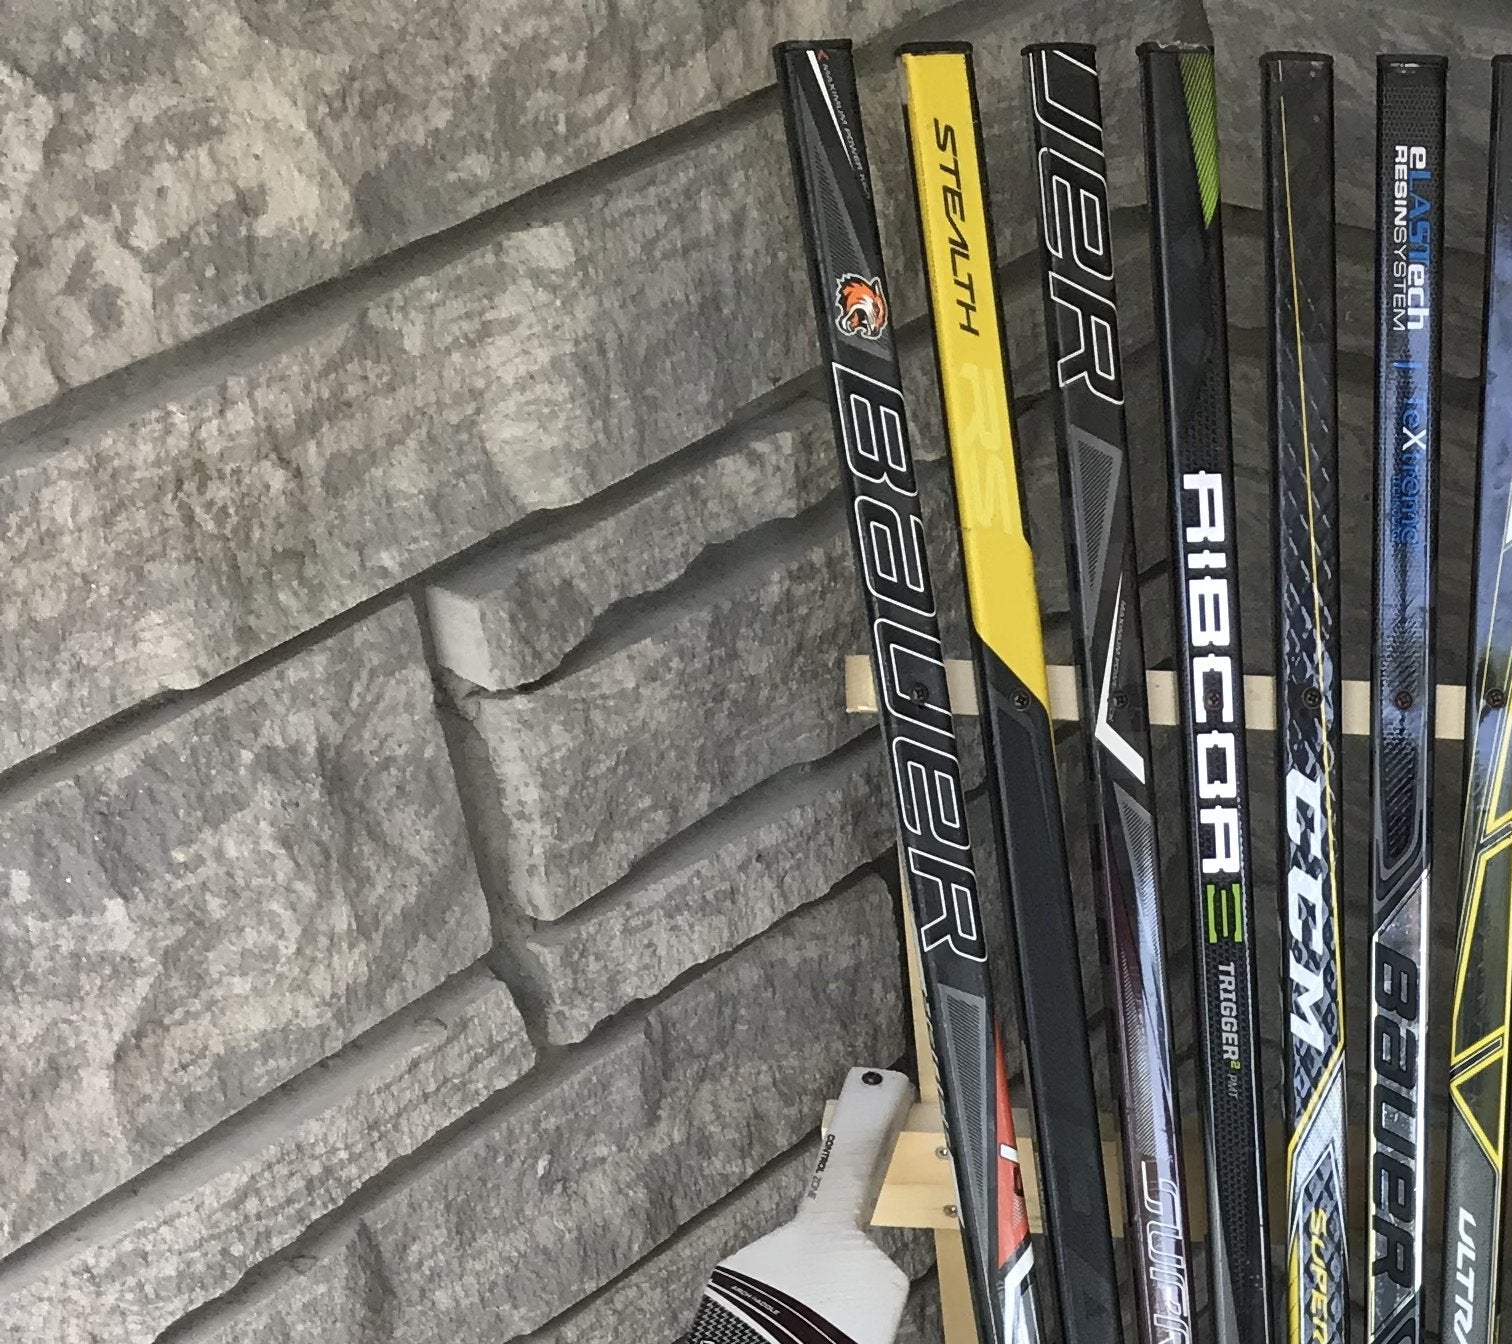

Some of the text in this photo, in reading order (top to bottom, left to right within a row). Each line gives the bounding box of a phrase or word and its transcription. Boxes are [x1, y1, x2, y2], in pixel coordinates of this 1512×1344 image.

[932, 118, 981, 337] STEALTH
[1284, 768, 1326, 1056] CCM
[807, 1134, 836, 1200] CONTROL ZONE
